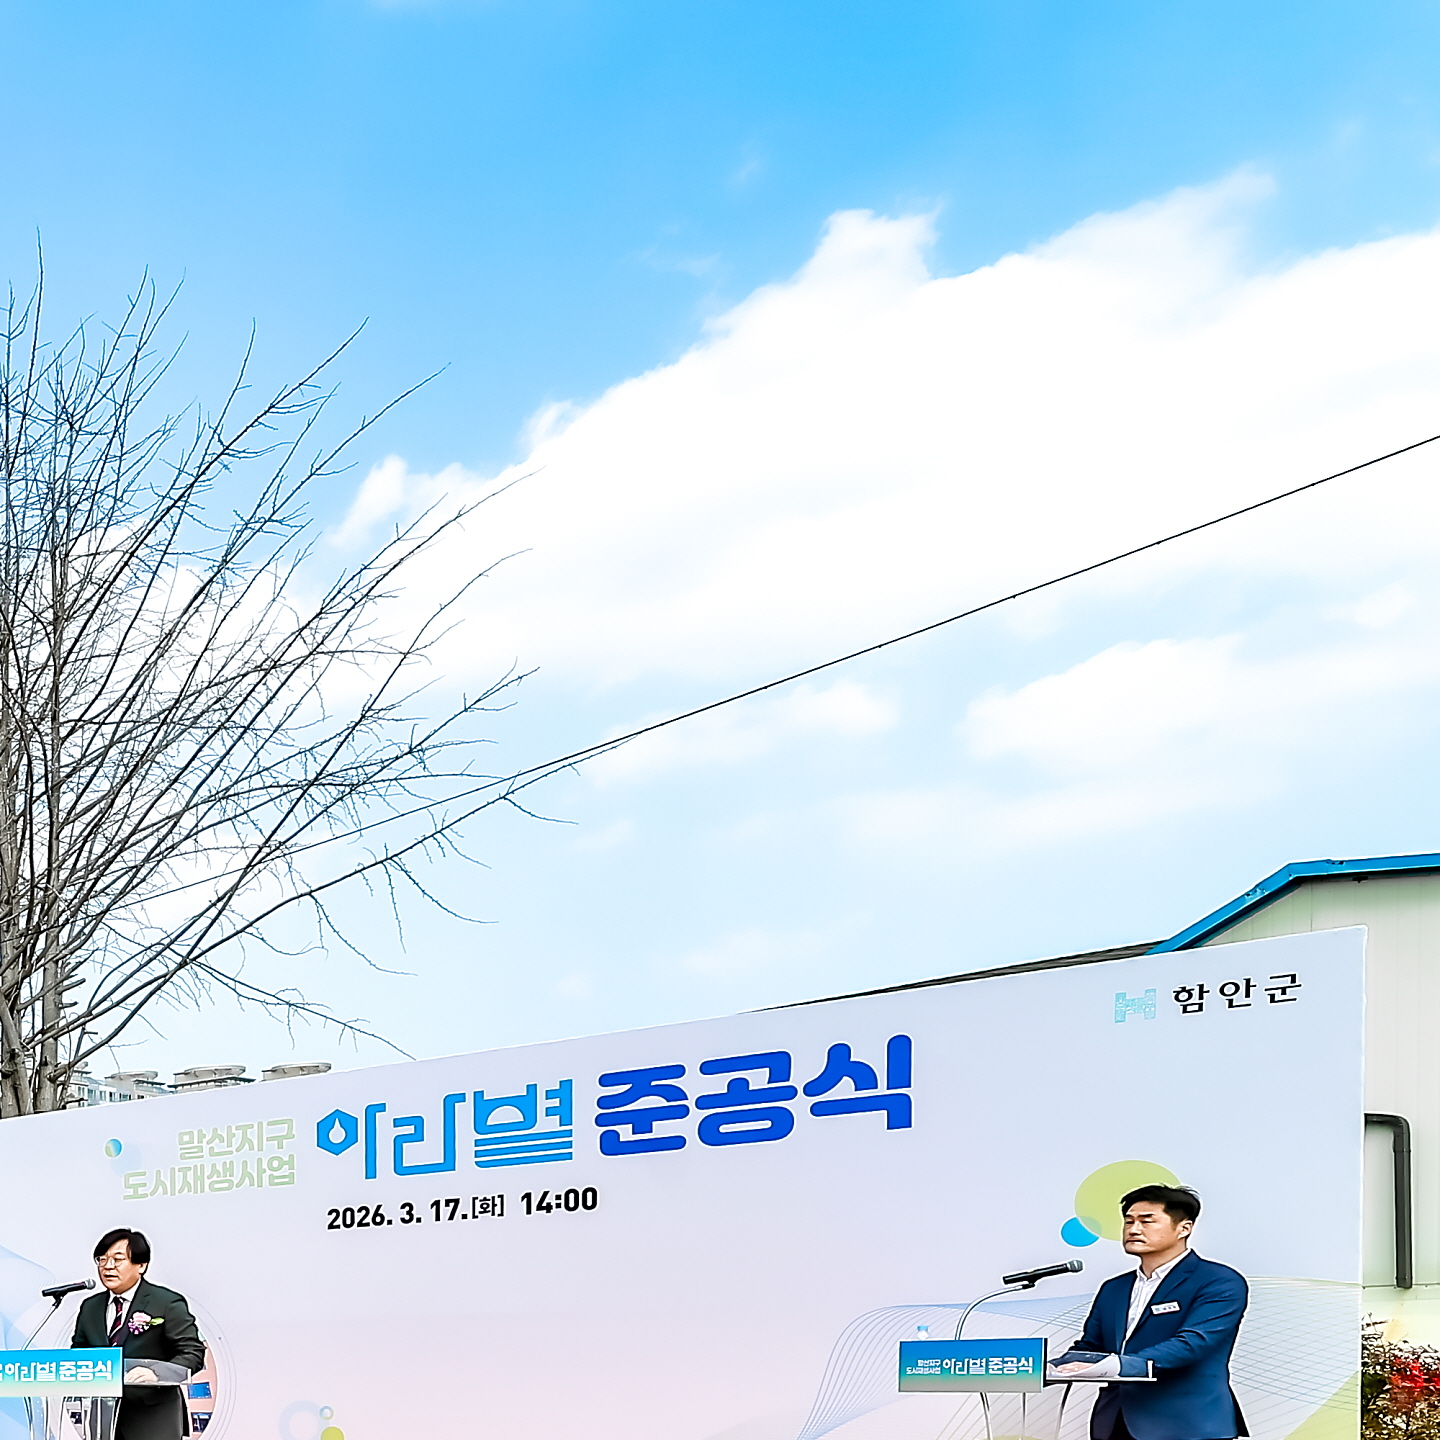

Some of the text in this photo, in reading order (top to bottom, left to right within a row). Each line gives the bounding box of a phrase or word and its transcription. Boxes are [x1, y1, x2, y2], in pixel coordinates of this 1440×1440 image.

[1173, 973, 1302, 1014] 함안군
[317, 1034, 912, 1180] 아라별 준공식
[178, 1118, 296, 1161] 말산지구
[123, 1154, 296, 1201] 도시재생사업
[327, 1203, 393, 1230] 2026.
[400, 1202, 423, 1225] 3.
[520, 1187, 599, 1216] 14:00
[5, 1360, 113, 1382] 아라별 준공식
[988, 1357, 1034, 1374] 준공식
